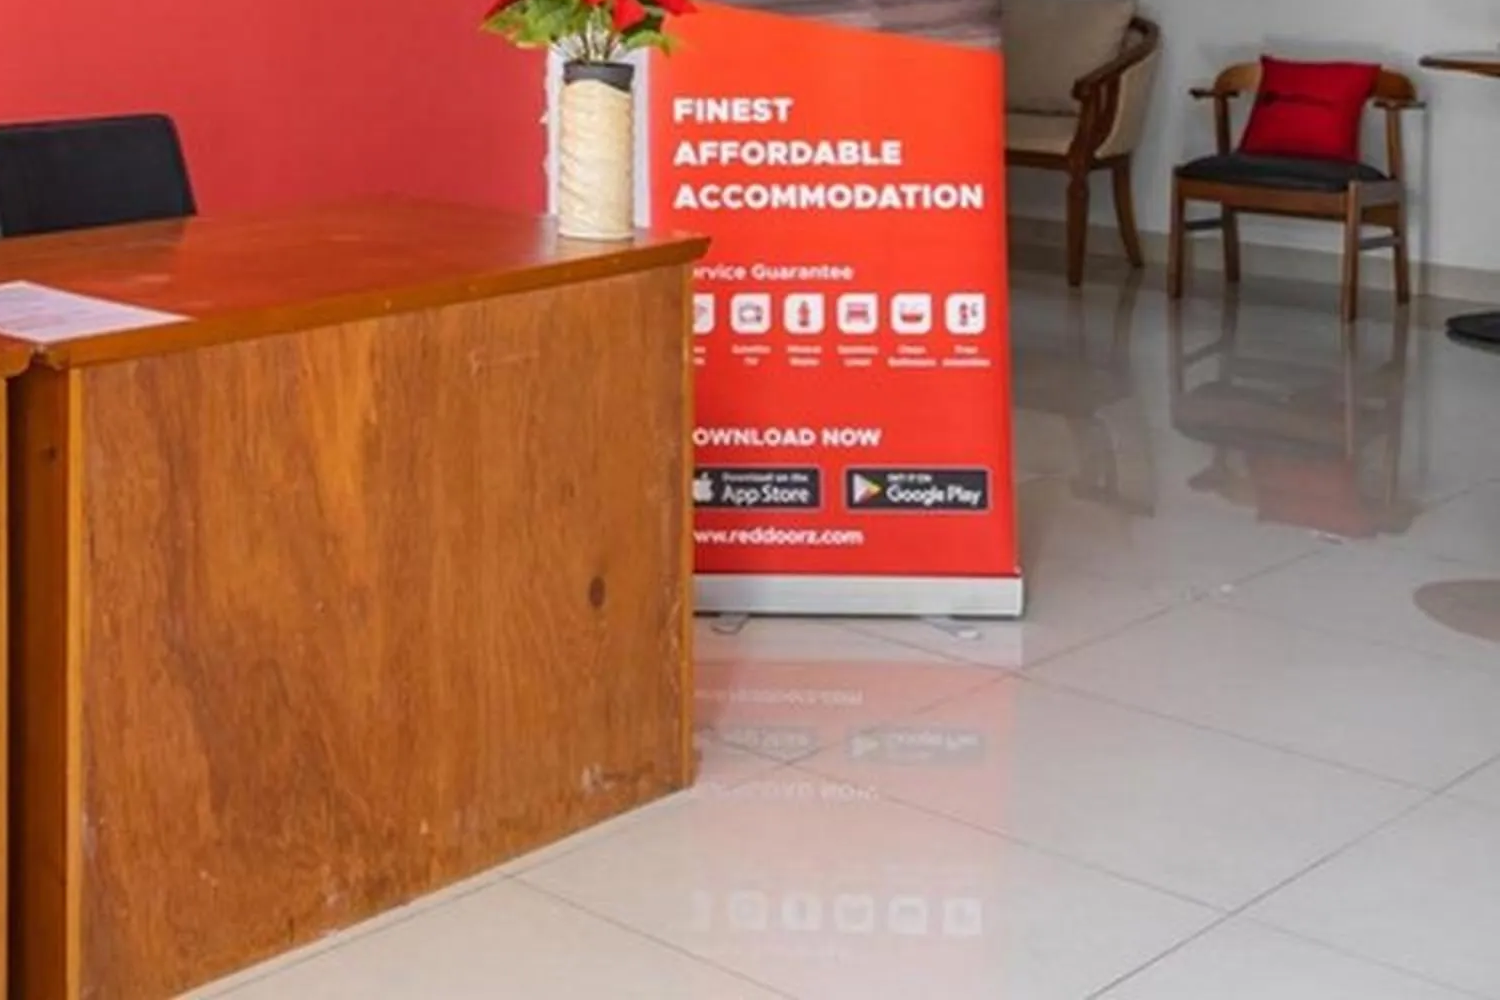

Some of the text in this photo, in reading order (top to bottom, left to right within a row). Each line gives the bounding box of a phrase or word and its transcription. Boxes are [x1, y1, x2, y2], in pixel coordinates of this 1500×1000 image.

[673, 97, 793, 123] FINEST
[673, 139, 902, 166] AFFORDABLE
[673, 183, 983, 210] ACCOMMODATION
[693, 263, 854, 281] rvice Guarantee
[692, 427, 882, 447] OWNLOAD NOW
[722, 485, 810, 506] App Store
[885, 484, 982, 506] Google Play
[694, 527, 864, 545] ww.reddoorz.com
